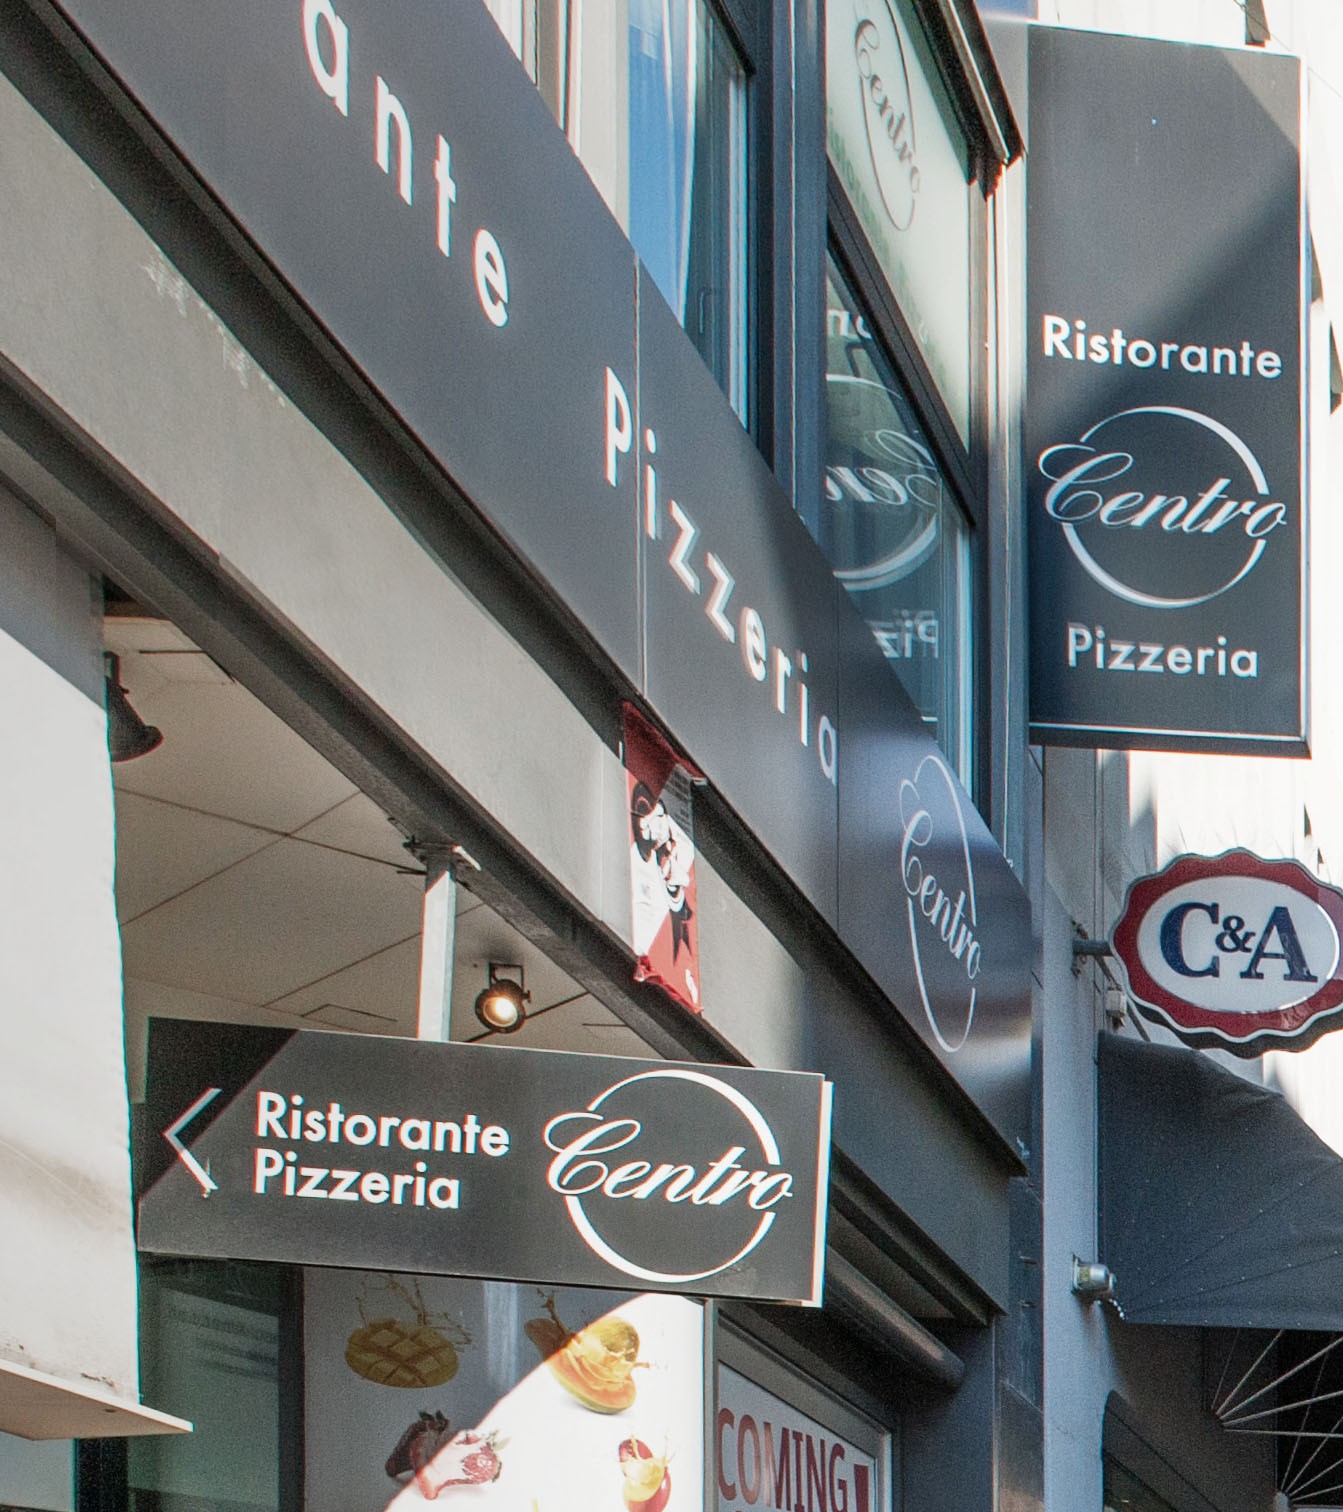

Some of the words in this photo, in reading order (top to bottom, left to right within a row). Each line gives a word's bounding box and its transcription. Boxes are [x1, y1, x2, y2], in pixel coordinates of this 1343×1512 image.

[1042, 314, 1283, 379] Ristorante
[1037, 442, 1288, 538] Centro
[605, 366, 838, 787] Pizzeria
[1066, 622, 1259, 678] Pizzeria
[900, 777, 983, 980] Centro
[1159, 901, 1319, 983] C&A
[255, 1090, 511, 1157] Ristorante
[543, 1112, 793, 1210] Centro
[253, 1148, 461, 1210] Pizzeria
